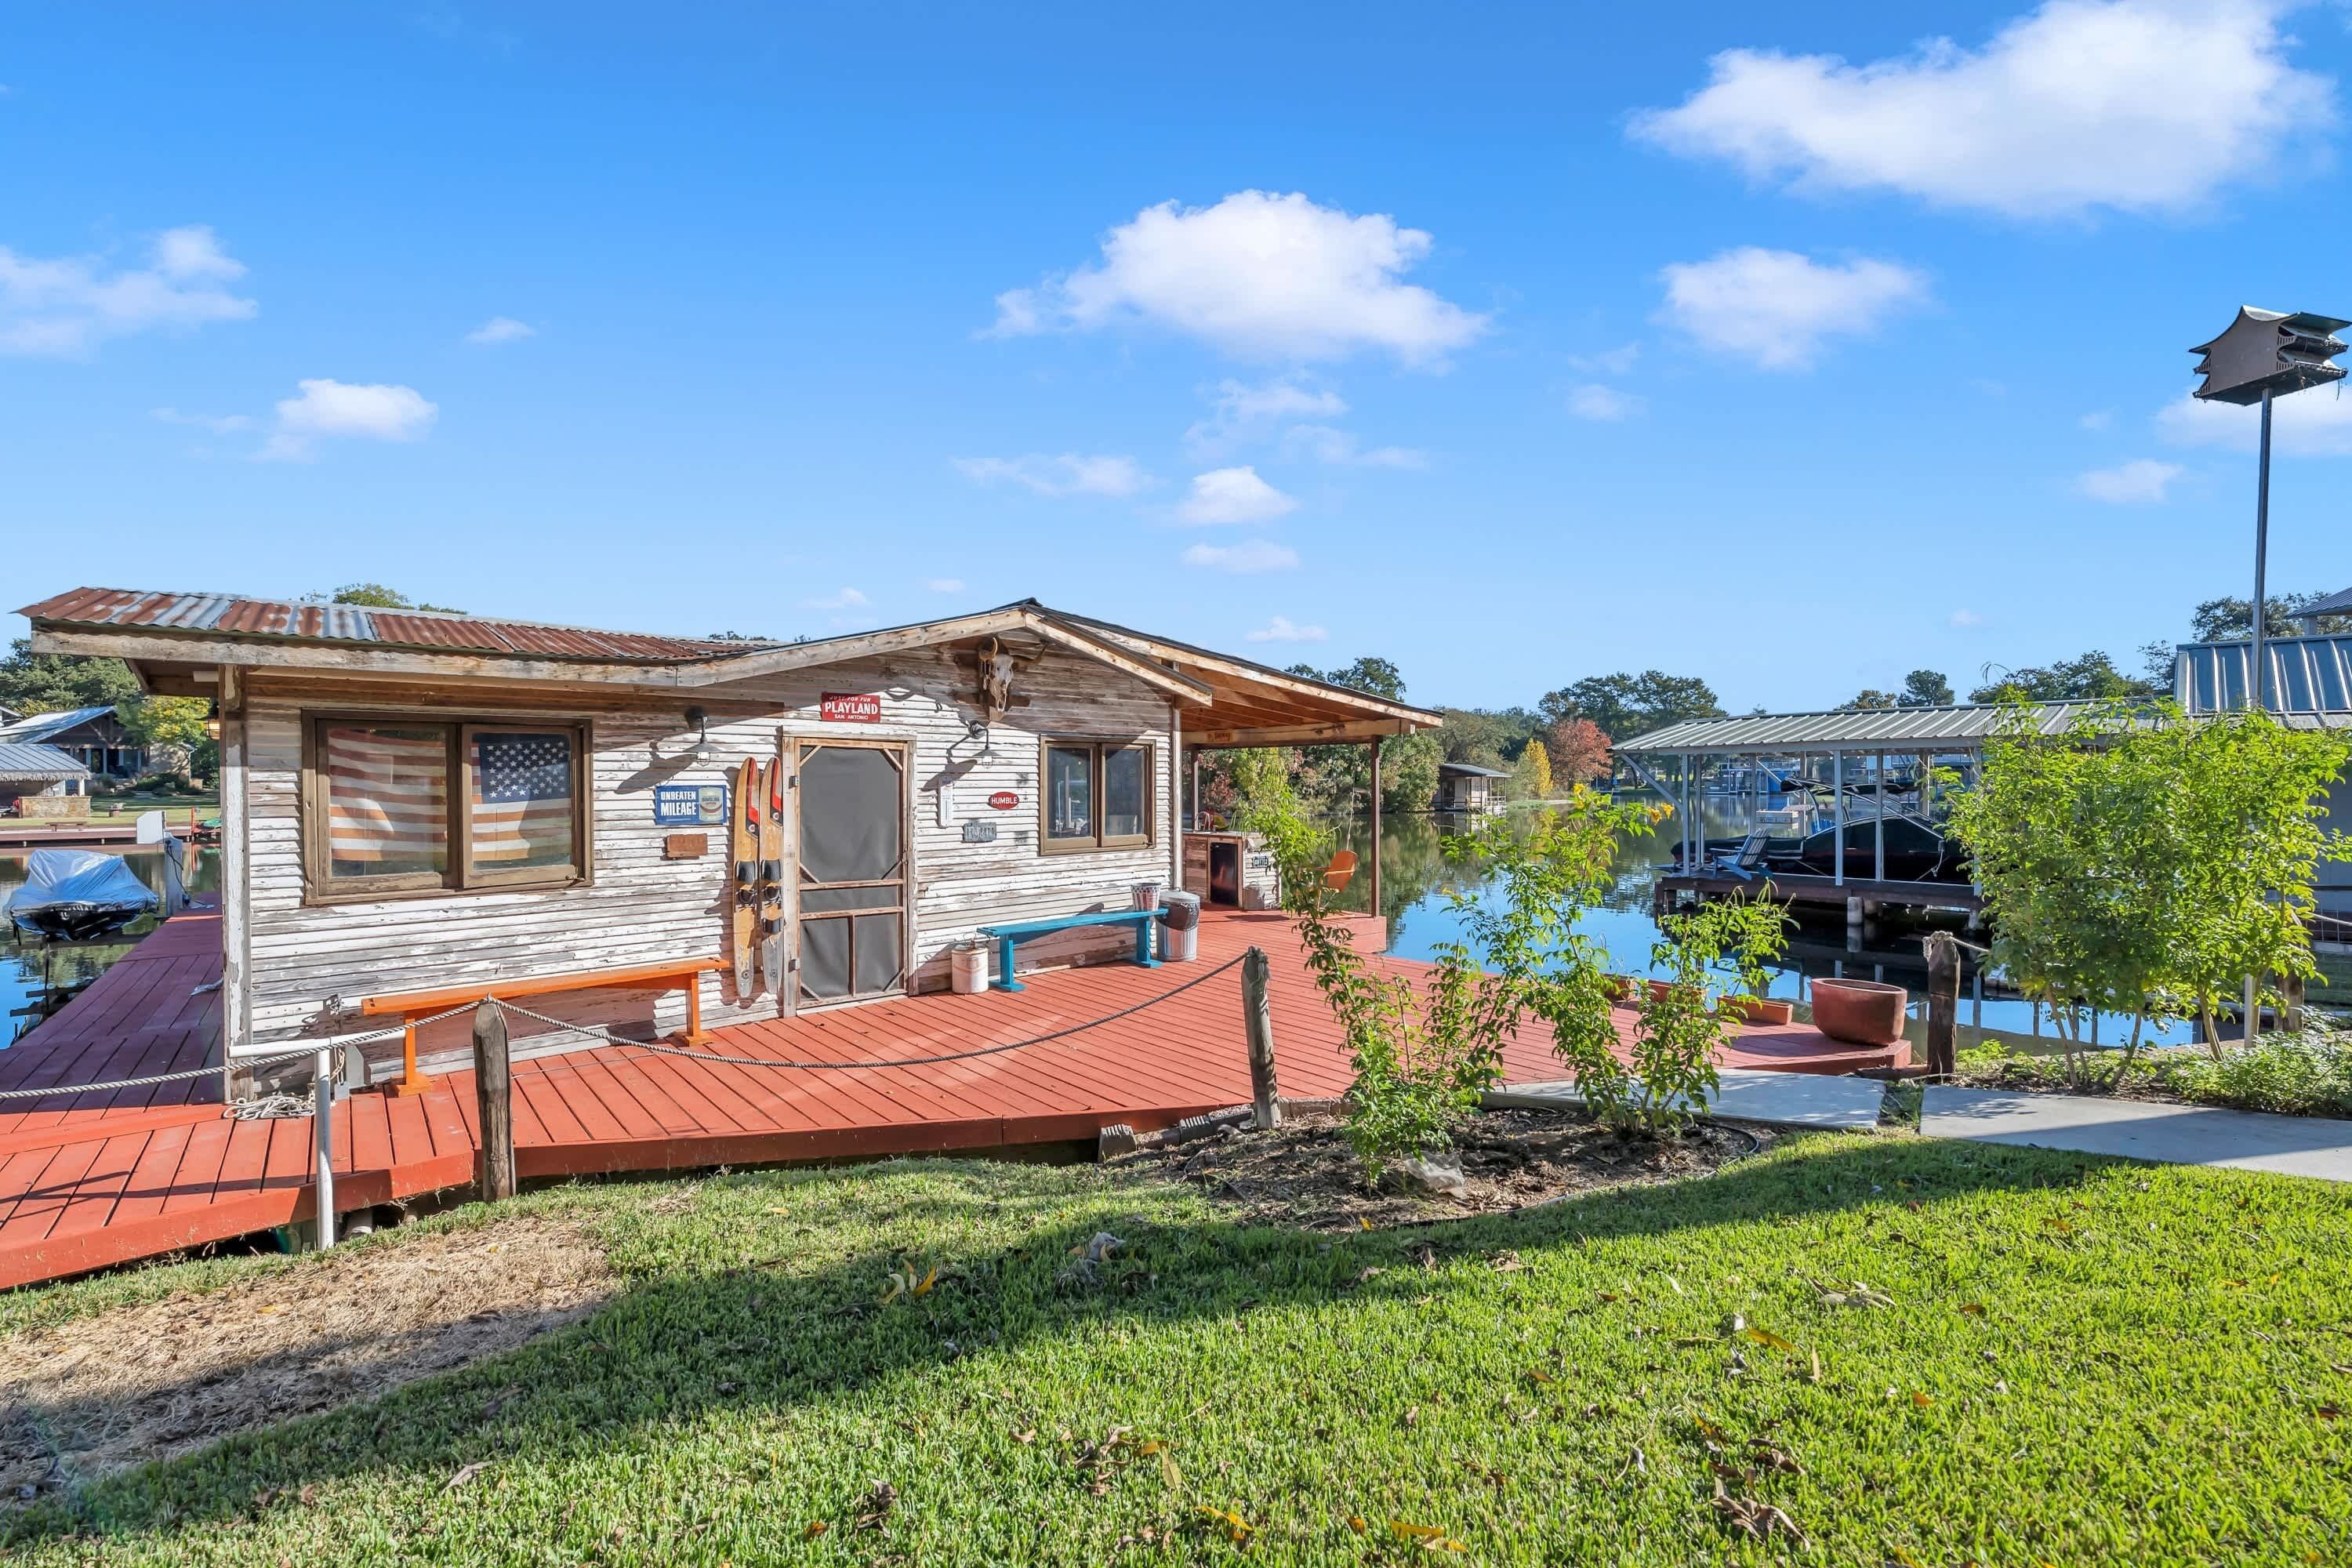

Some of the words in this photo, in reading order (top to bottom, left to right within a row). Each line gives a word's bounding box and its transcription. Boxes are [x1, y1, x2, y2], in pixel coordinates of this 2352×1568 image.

[825, 702, 878, 714] PLAYLAND
[661, 791, 696, 800] UNBEATEN
[661, 802, 697, 816] MILEAGE
